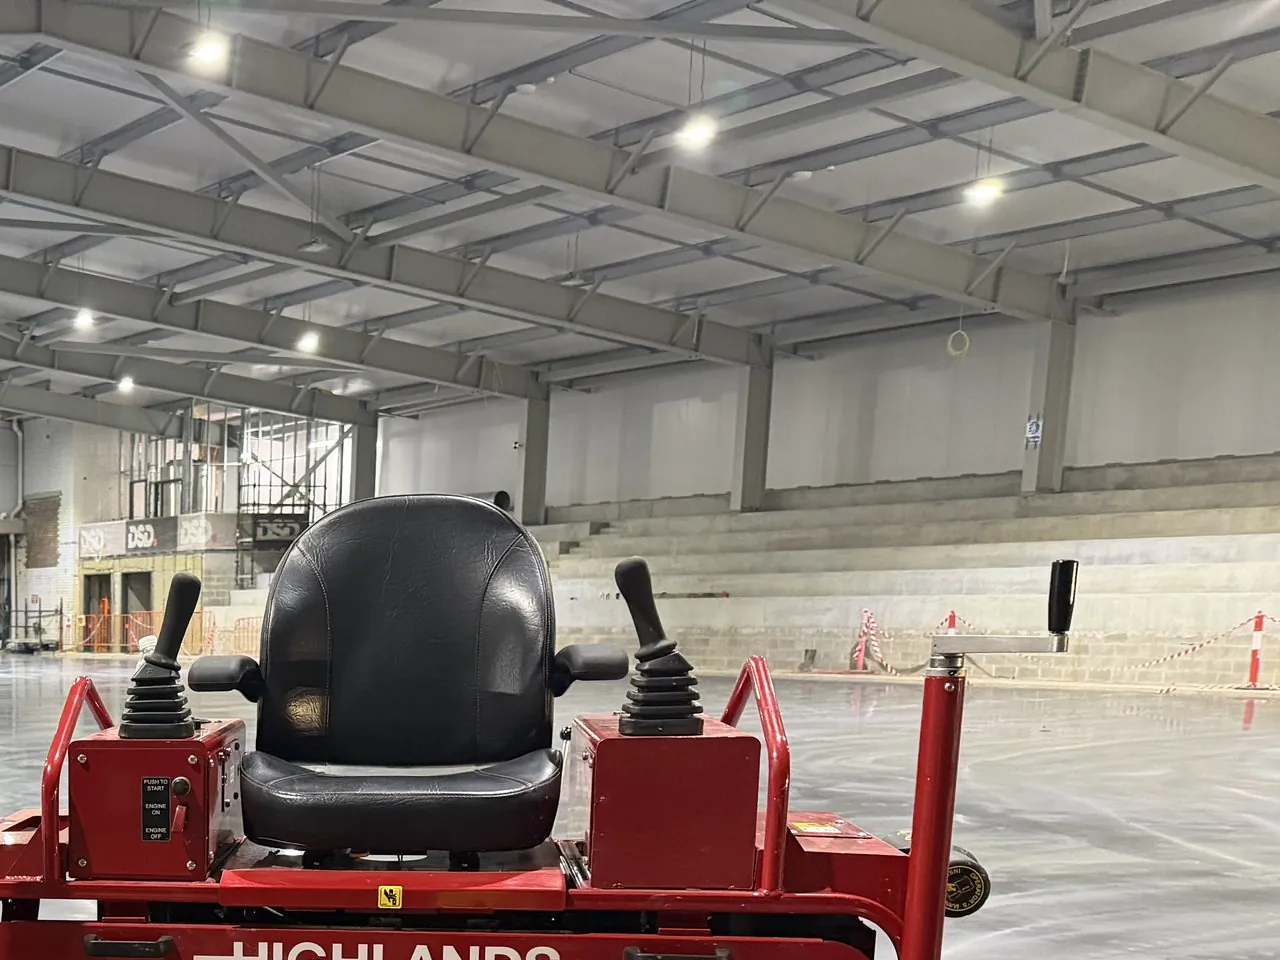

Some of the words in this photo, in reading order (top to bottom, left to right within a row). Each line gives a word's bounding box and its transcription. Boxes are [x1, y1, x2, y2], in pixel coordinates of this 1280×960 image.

[128, 524, 154, 549] DSD
[180, 520, 212, 544] DSD
[256, 519, 300, 541] DSD
